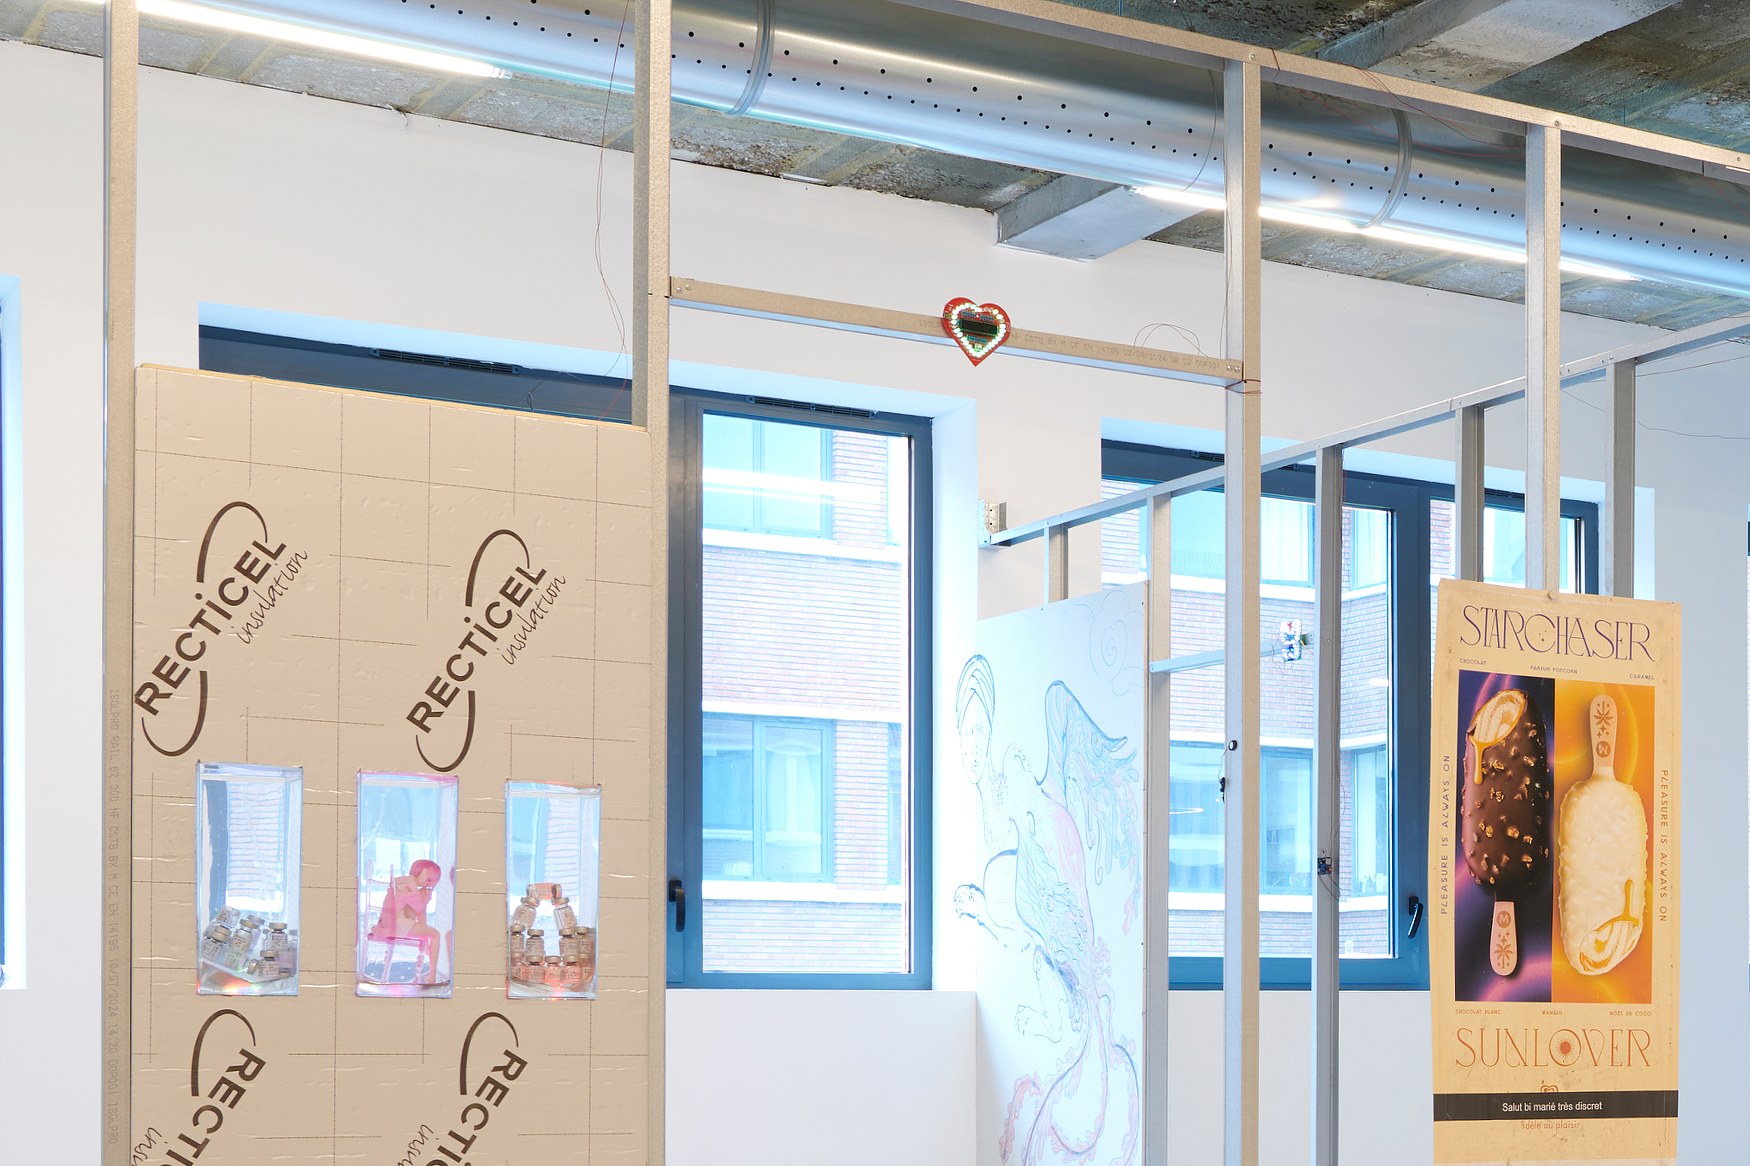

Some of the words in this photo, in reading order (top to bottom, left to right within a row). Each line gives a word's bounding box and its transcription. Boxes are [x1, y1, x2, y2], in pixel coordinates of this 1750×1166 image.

[236, 549, 308, 645] insulation
[502, 574, 567, 665] insulation
[135, 537, 287, 716] RECTICEL
[405, 564, 547, 734] RECTICEL
[1460, 605, 1656, 663] STARCHASER
[1459, 658, 1487, 666] CHOCOLAT
[1442, 755, 1450, 772] ON
[1441, 780, 1450, 828] ALWAYS
[1660, 769, 1669, 828] PLEASURE
[1441, 837, 1449, 847] IS
[1660, 834, 1668, 844] IS
[1440, 855, 1449, 915] PLEASURE
[1660, 852, 1668, 898] ALWAYS
[1659, 906, 1668, 922] ON
[1455, 1027, 1652, 1068] SUNLOVER
[1502, 1102, 1523, 1112] Salut
[1524, 1102, 1532, 1111] bi
[1533, 1101, 1556, 1111] marié
[1558, 1101, 1574, 1111] très
[1575, 1101, 1603, 1110] discret
[1521, 1120, 1541, 1130] fidèle
[1555, 1120, 1581, 1131] plaisir
